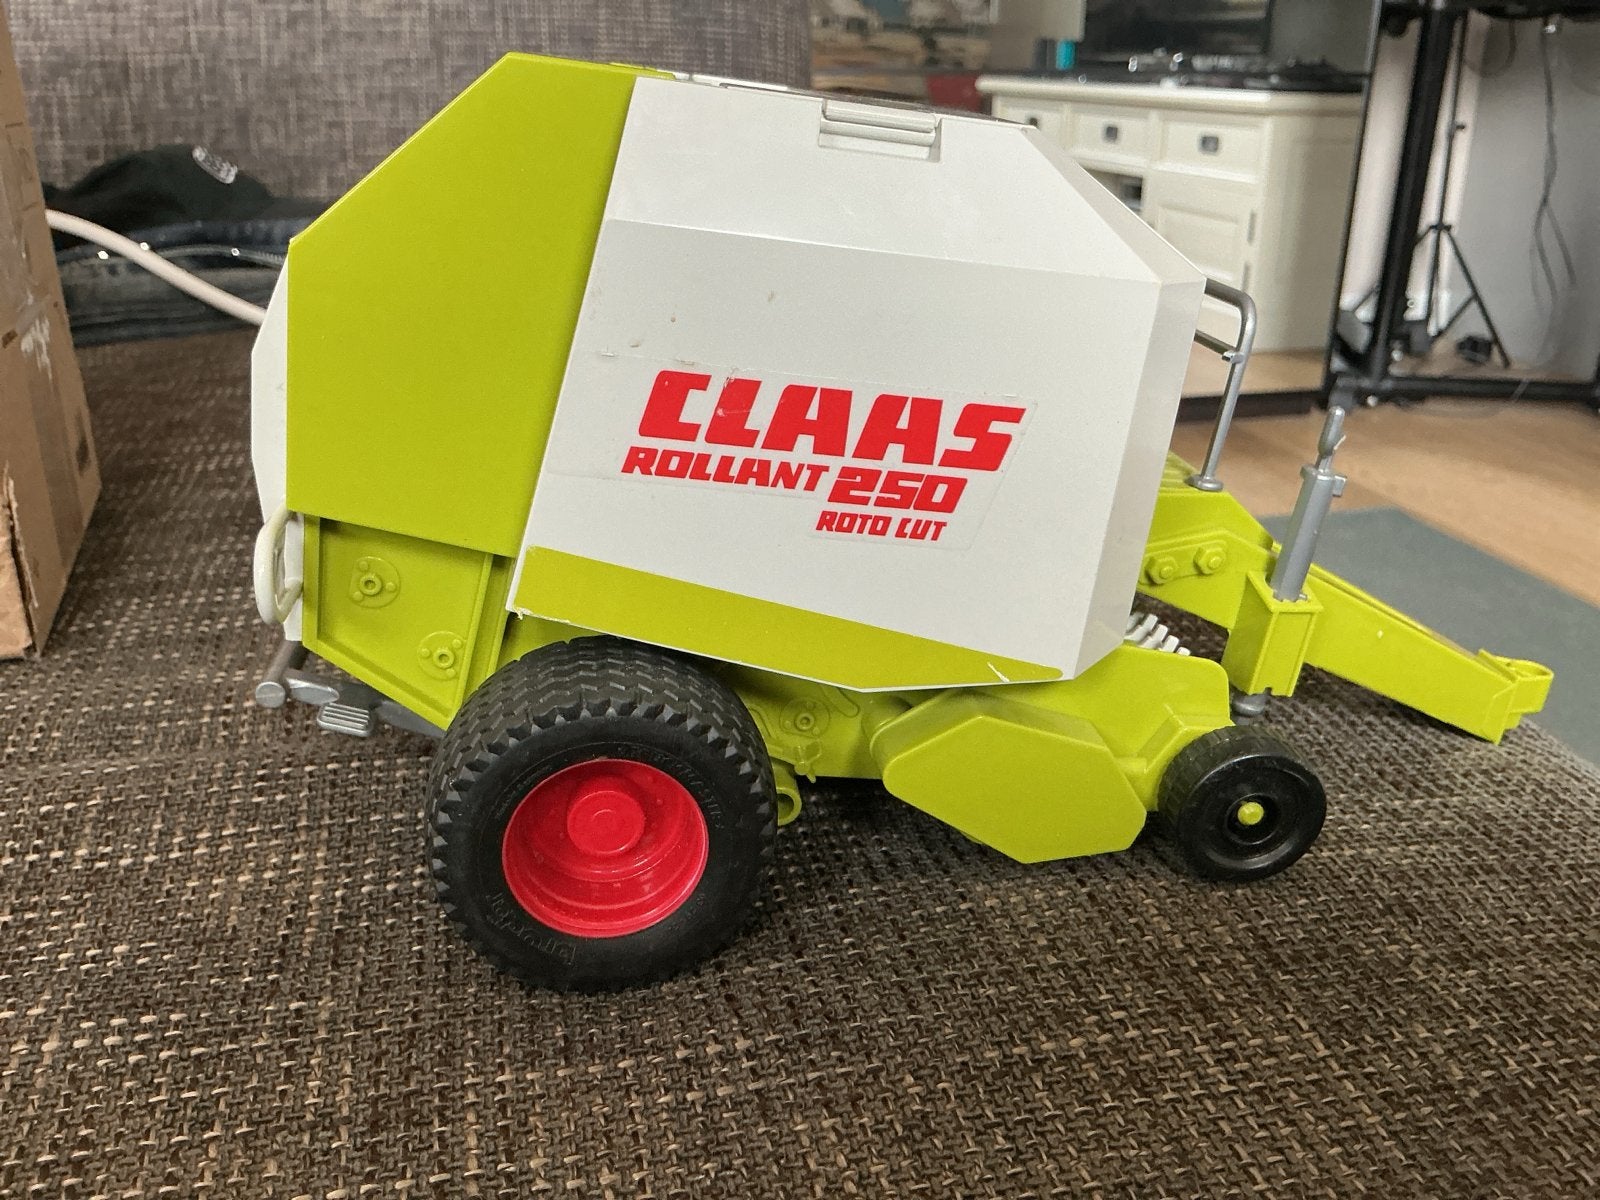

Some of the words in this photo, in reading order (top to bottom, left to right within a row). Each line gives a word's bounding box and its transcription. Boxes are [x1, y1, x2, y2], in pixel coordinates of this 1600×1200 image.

[638, 369, 1026, 472] CLAAS
[621, 446, 830, 492] ROLLANT
[827, 466, 968, 514] 250
[815, 510, 893, 537] ROTO
[894, 517, 947, 541] CUT
